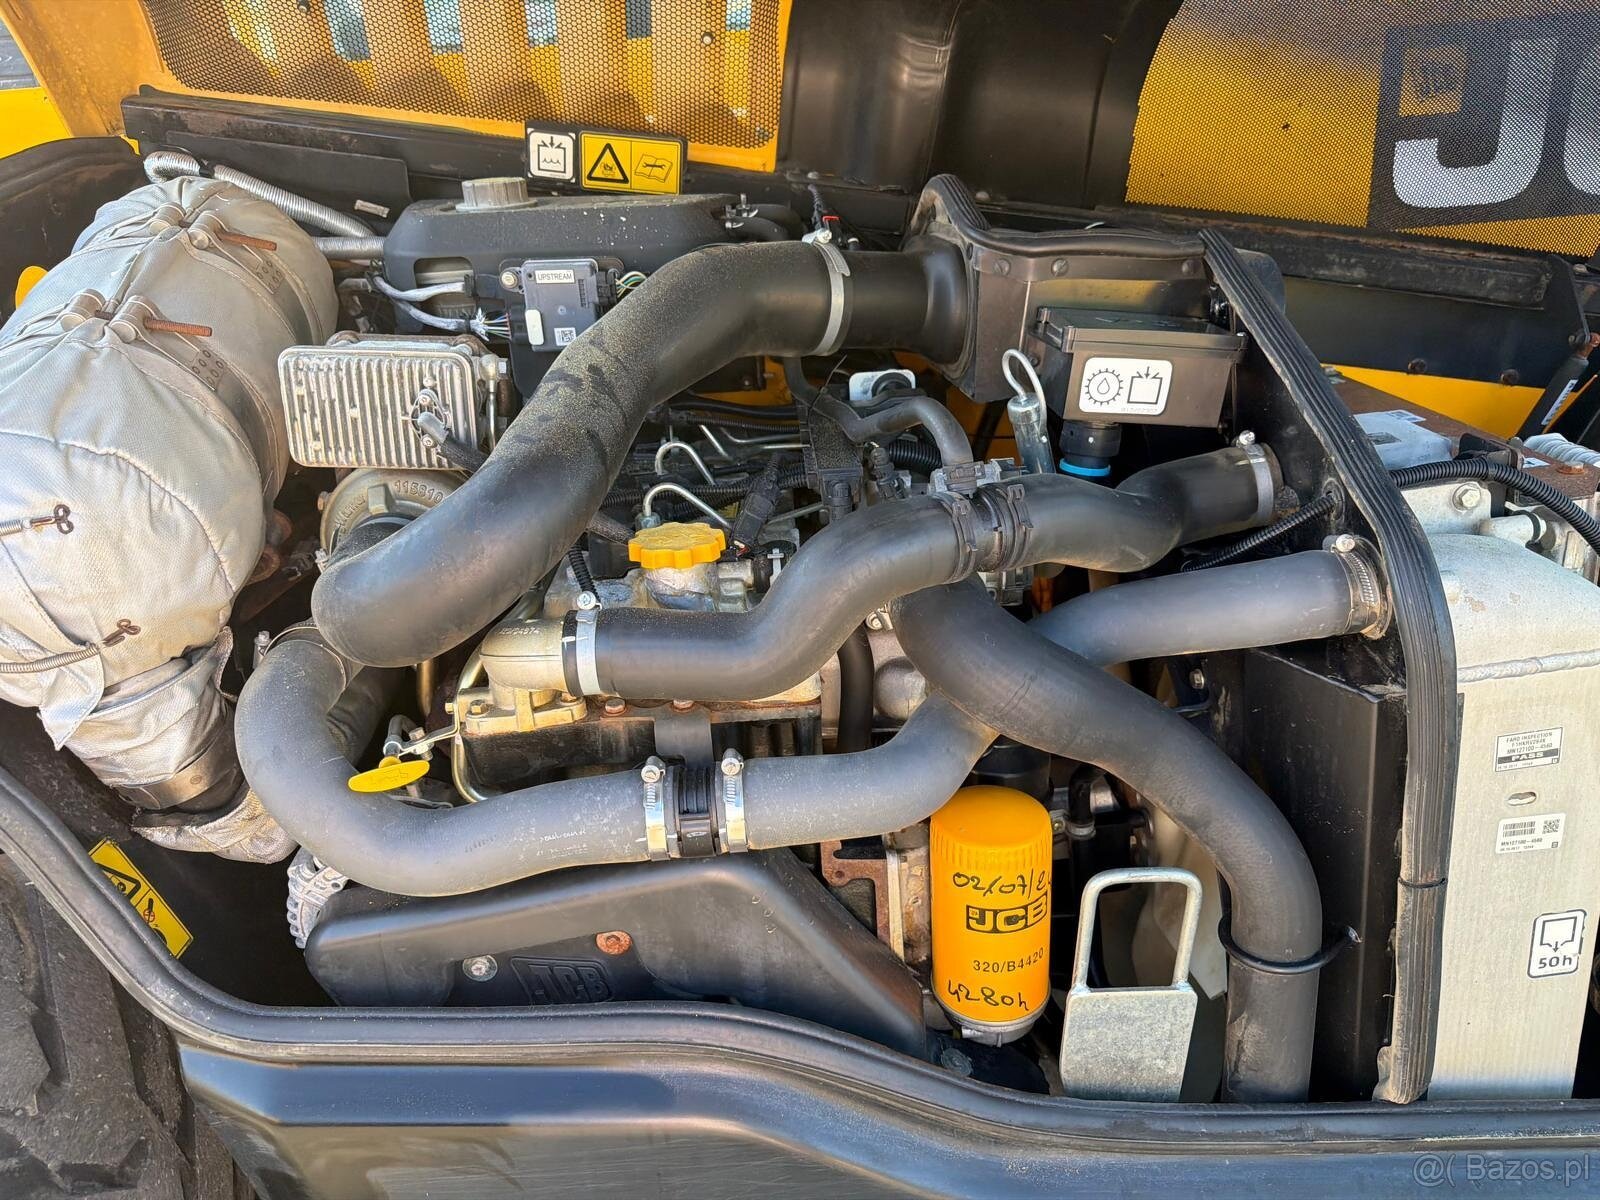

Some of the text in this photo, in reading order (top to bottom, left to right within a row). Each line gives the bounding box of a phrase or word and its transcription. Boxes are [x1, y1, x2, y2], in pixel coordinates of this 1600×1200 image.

[1393, 37, 1600, 209] J
[536, 272, 573, 281] UPSTREAM
[1511, 751, 1544, 762] PASS
[966, 890, 1048, 933] JCB
[973, 946, 1044, 973] 320/B4420
